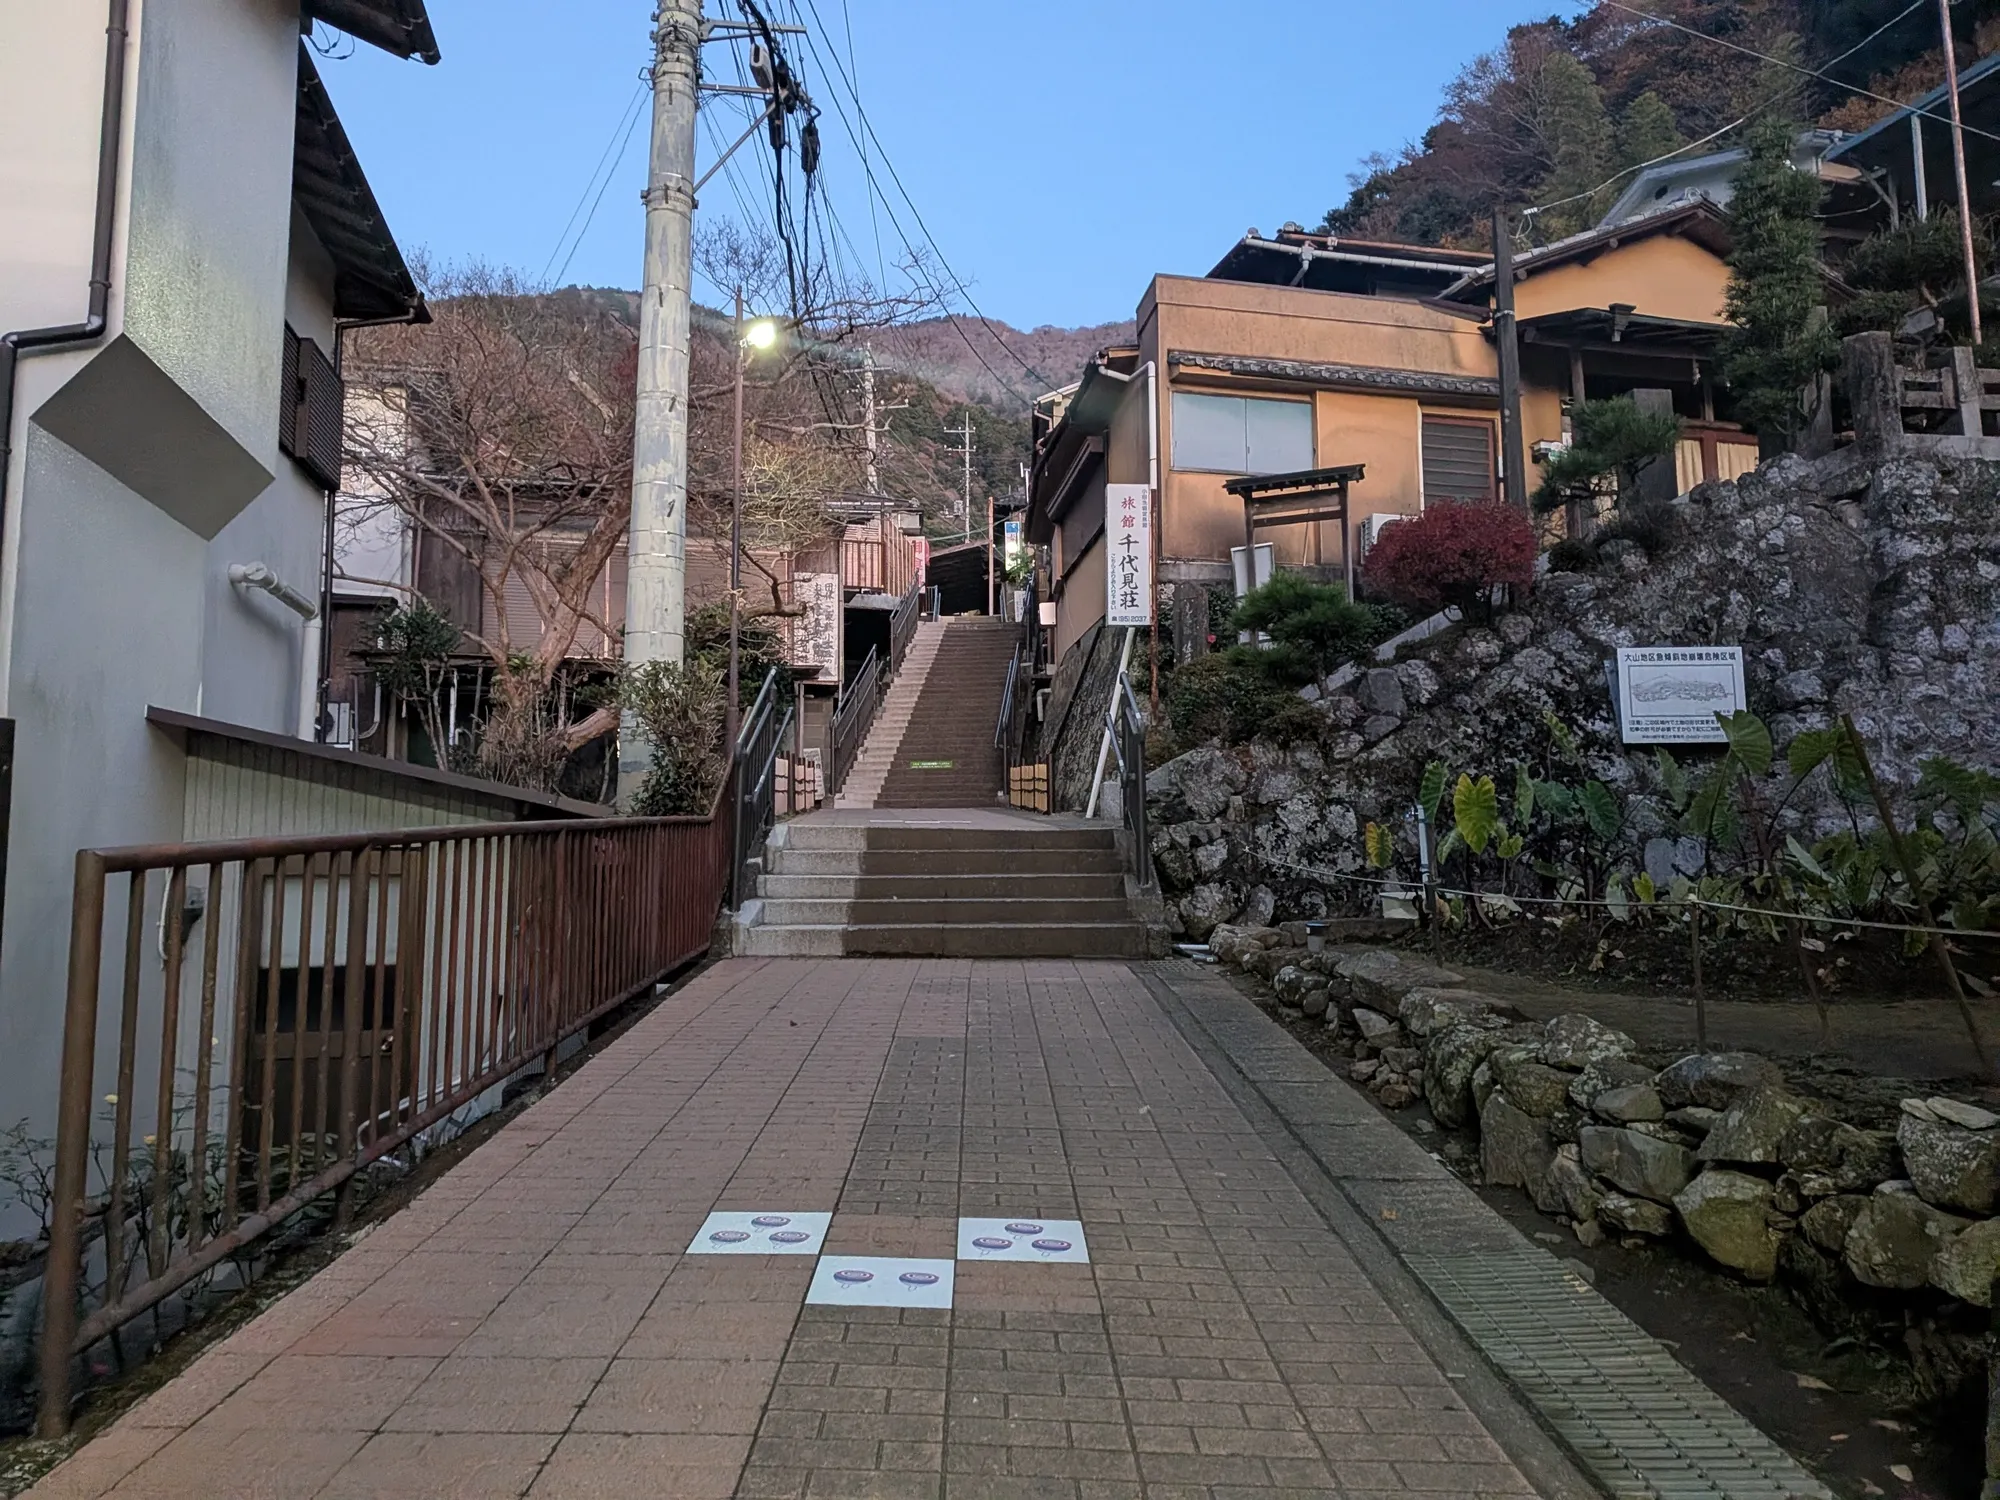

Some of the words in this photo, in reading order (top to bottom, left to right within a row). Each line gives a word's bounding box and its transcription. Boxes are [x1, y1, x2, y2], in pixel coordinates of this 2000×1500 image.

[1624, 652, 1737, 662] 大山地区急傾斜地崩壊危険区域
